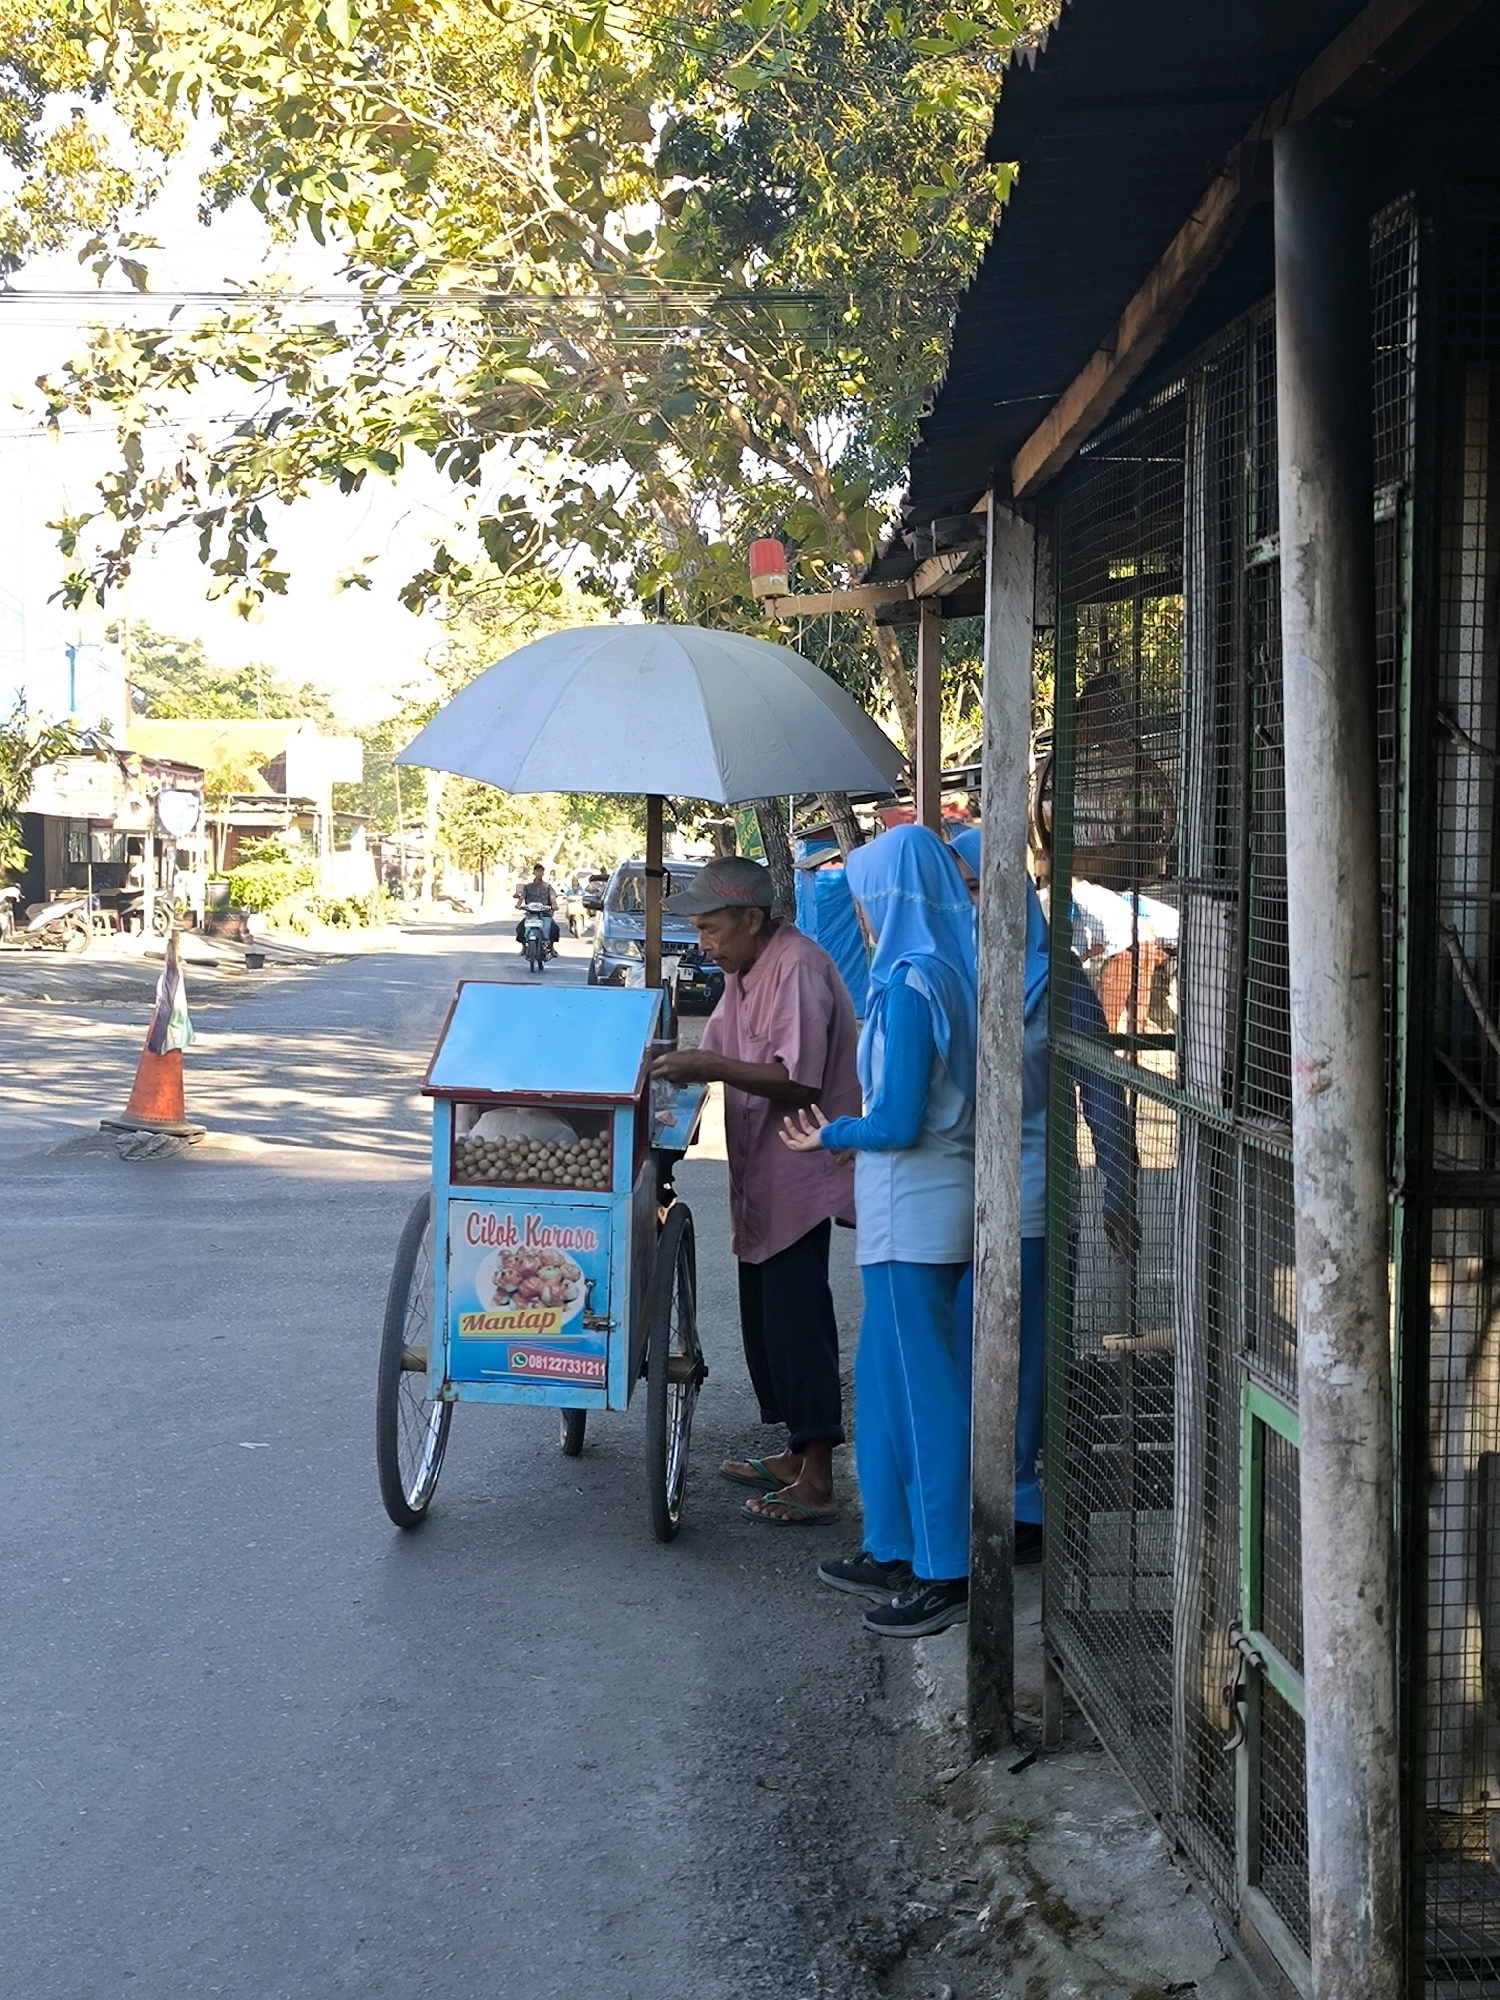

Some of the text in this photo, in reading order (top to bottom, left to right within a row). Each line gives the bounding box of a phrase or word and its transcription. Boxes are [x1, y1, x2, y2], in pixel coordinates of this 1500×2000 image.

[466, 1212, 597, 1250] Cilok Karasa
[463, 1312, 556, 1334] Mantap
